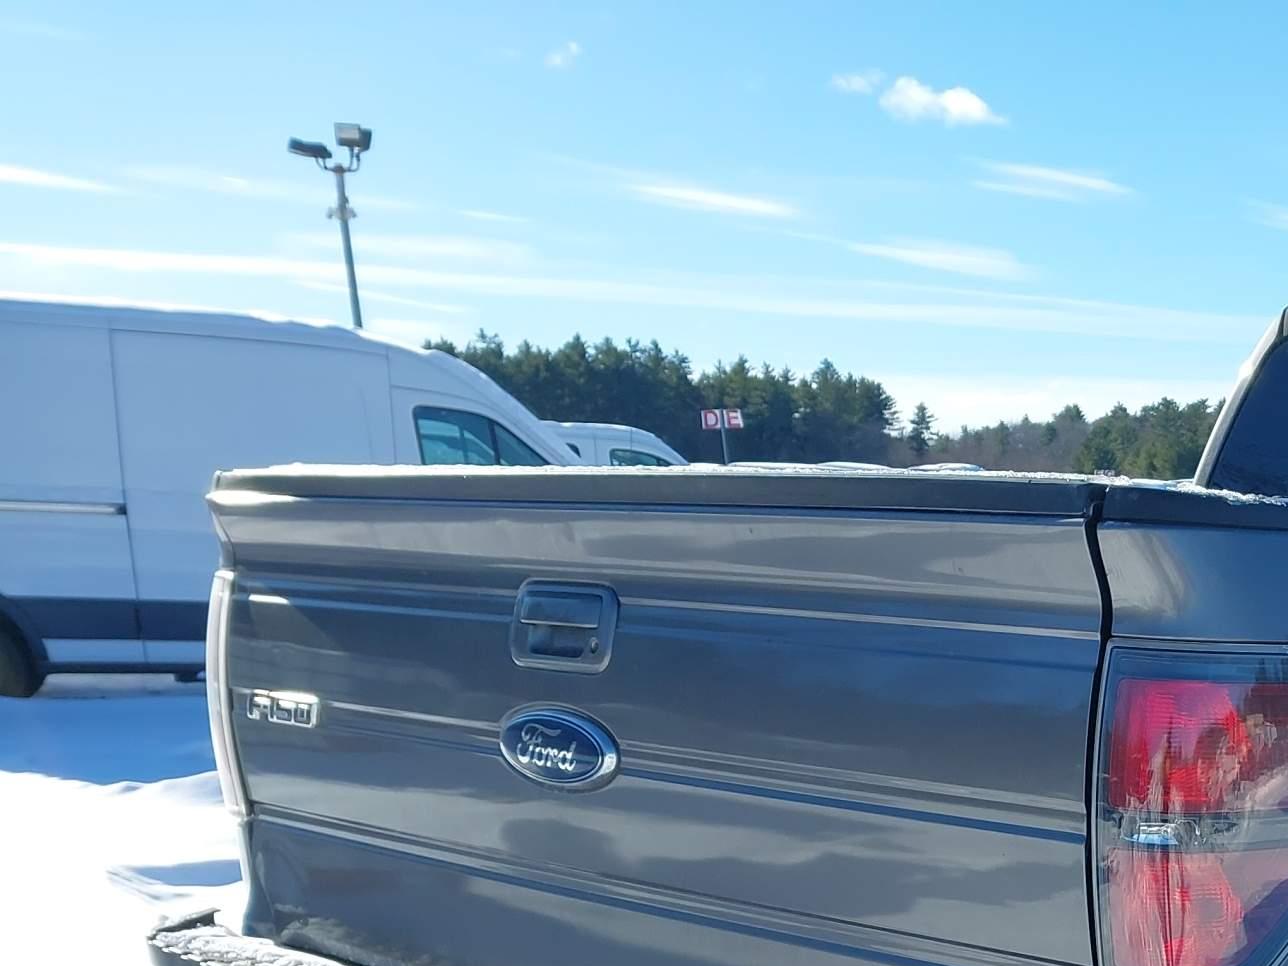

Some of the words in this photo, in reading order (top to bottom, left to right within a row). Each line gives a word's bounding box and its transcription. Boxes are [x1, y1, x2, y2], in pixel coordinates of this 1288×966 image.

[703, 409, 719, 429] D
[726, 409, 742, 429] E
[516, 723, 577, 771] Ford
